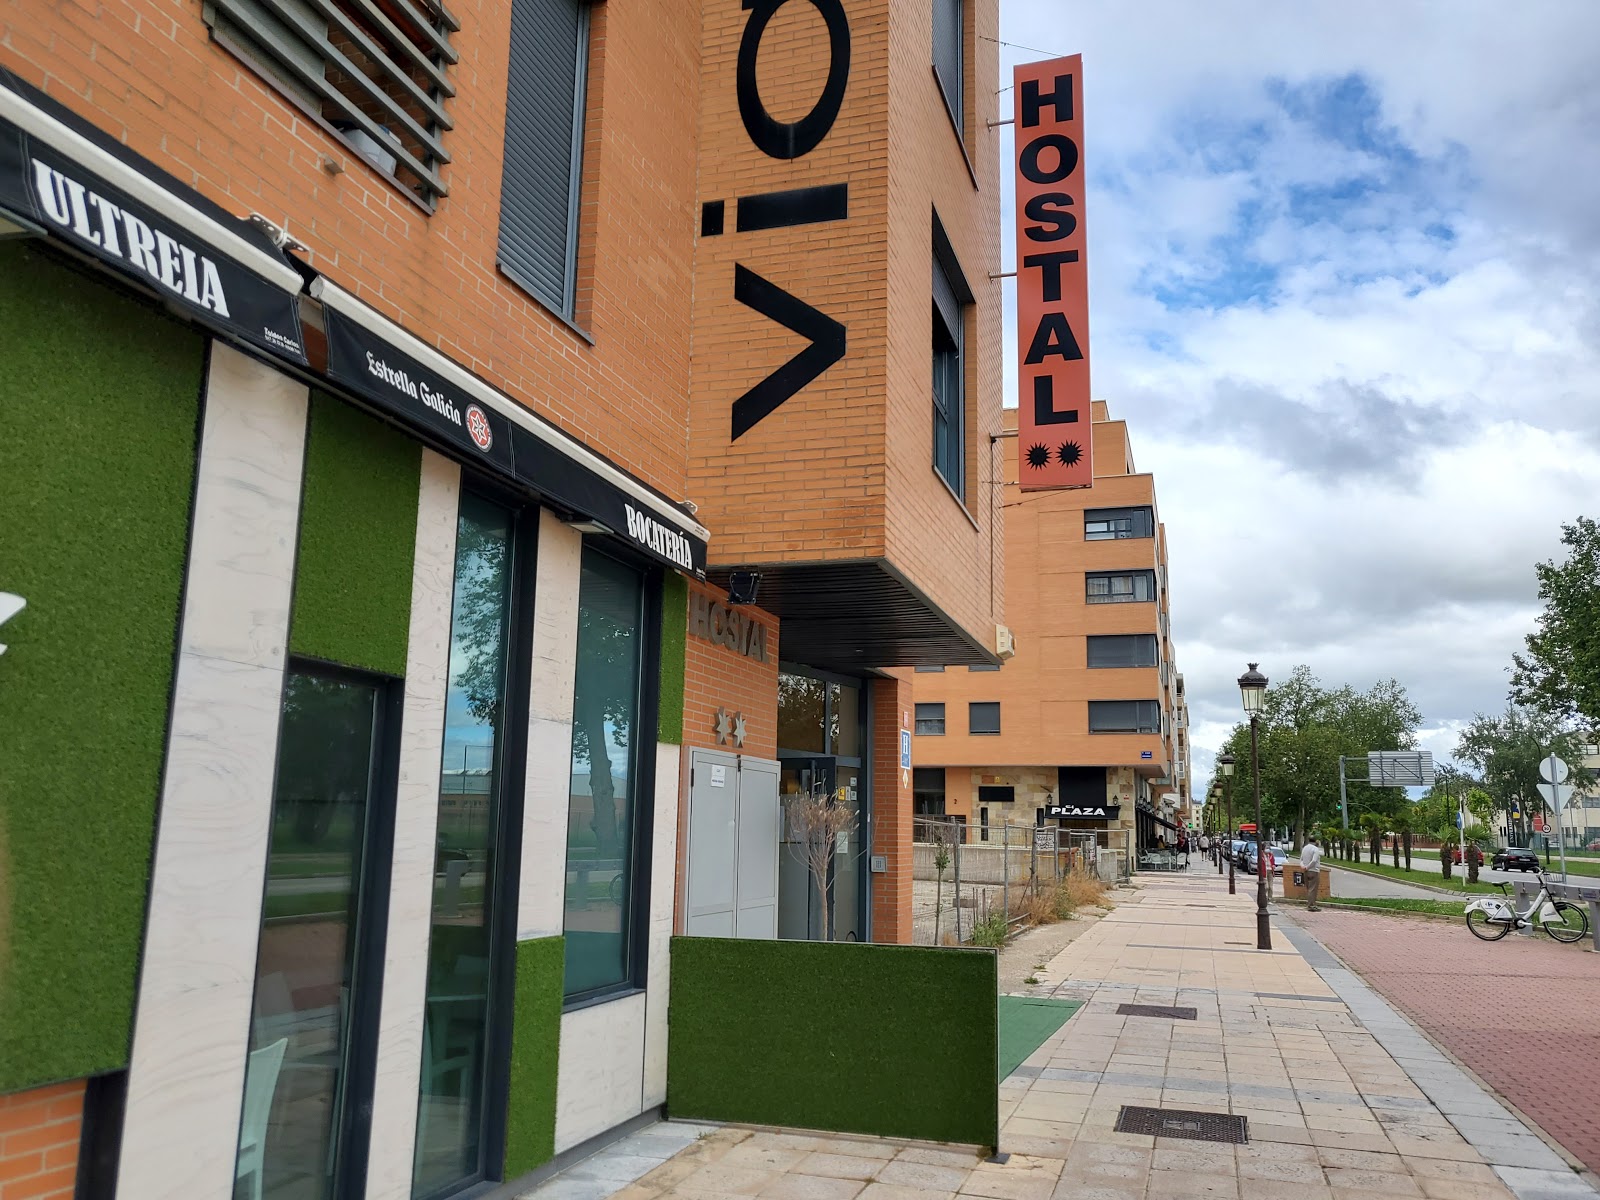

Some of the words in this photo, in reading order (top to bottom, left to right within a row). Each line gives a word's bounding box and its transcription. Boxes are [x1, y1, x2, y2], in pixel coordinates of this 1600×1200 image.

[32, 158, 230, 318] ULTREIA
[1018, 73, 1084, 426] HOSTAL
[366, 350, 418, 400] Estrella
[420, 381, 462, 426] Galicia
[624, 503, 693, 570] BOCATERÍA
[689, 588, 770, 665] HOSTAL
[1051, 807, 1106, 816] PLAZA
